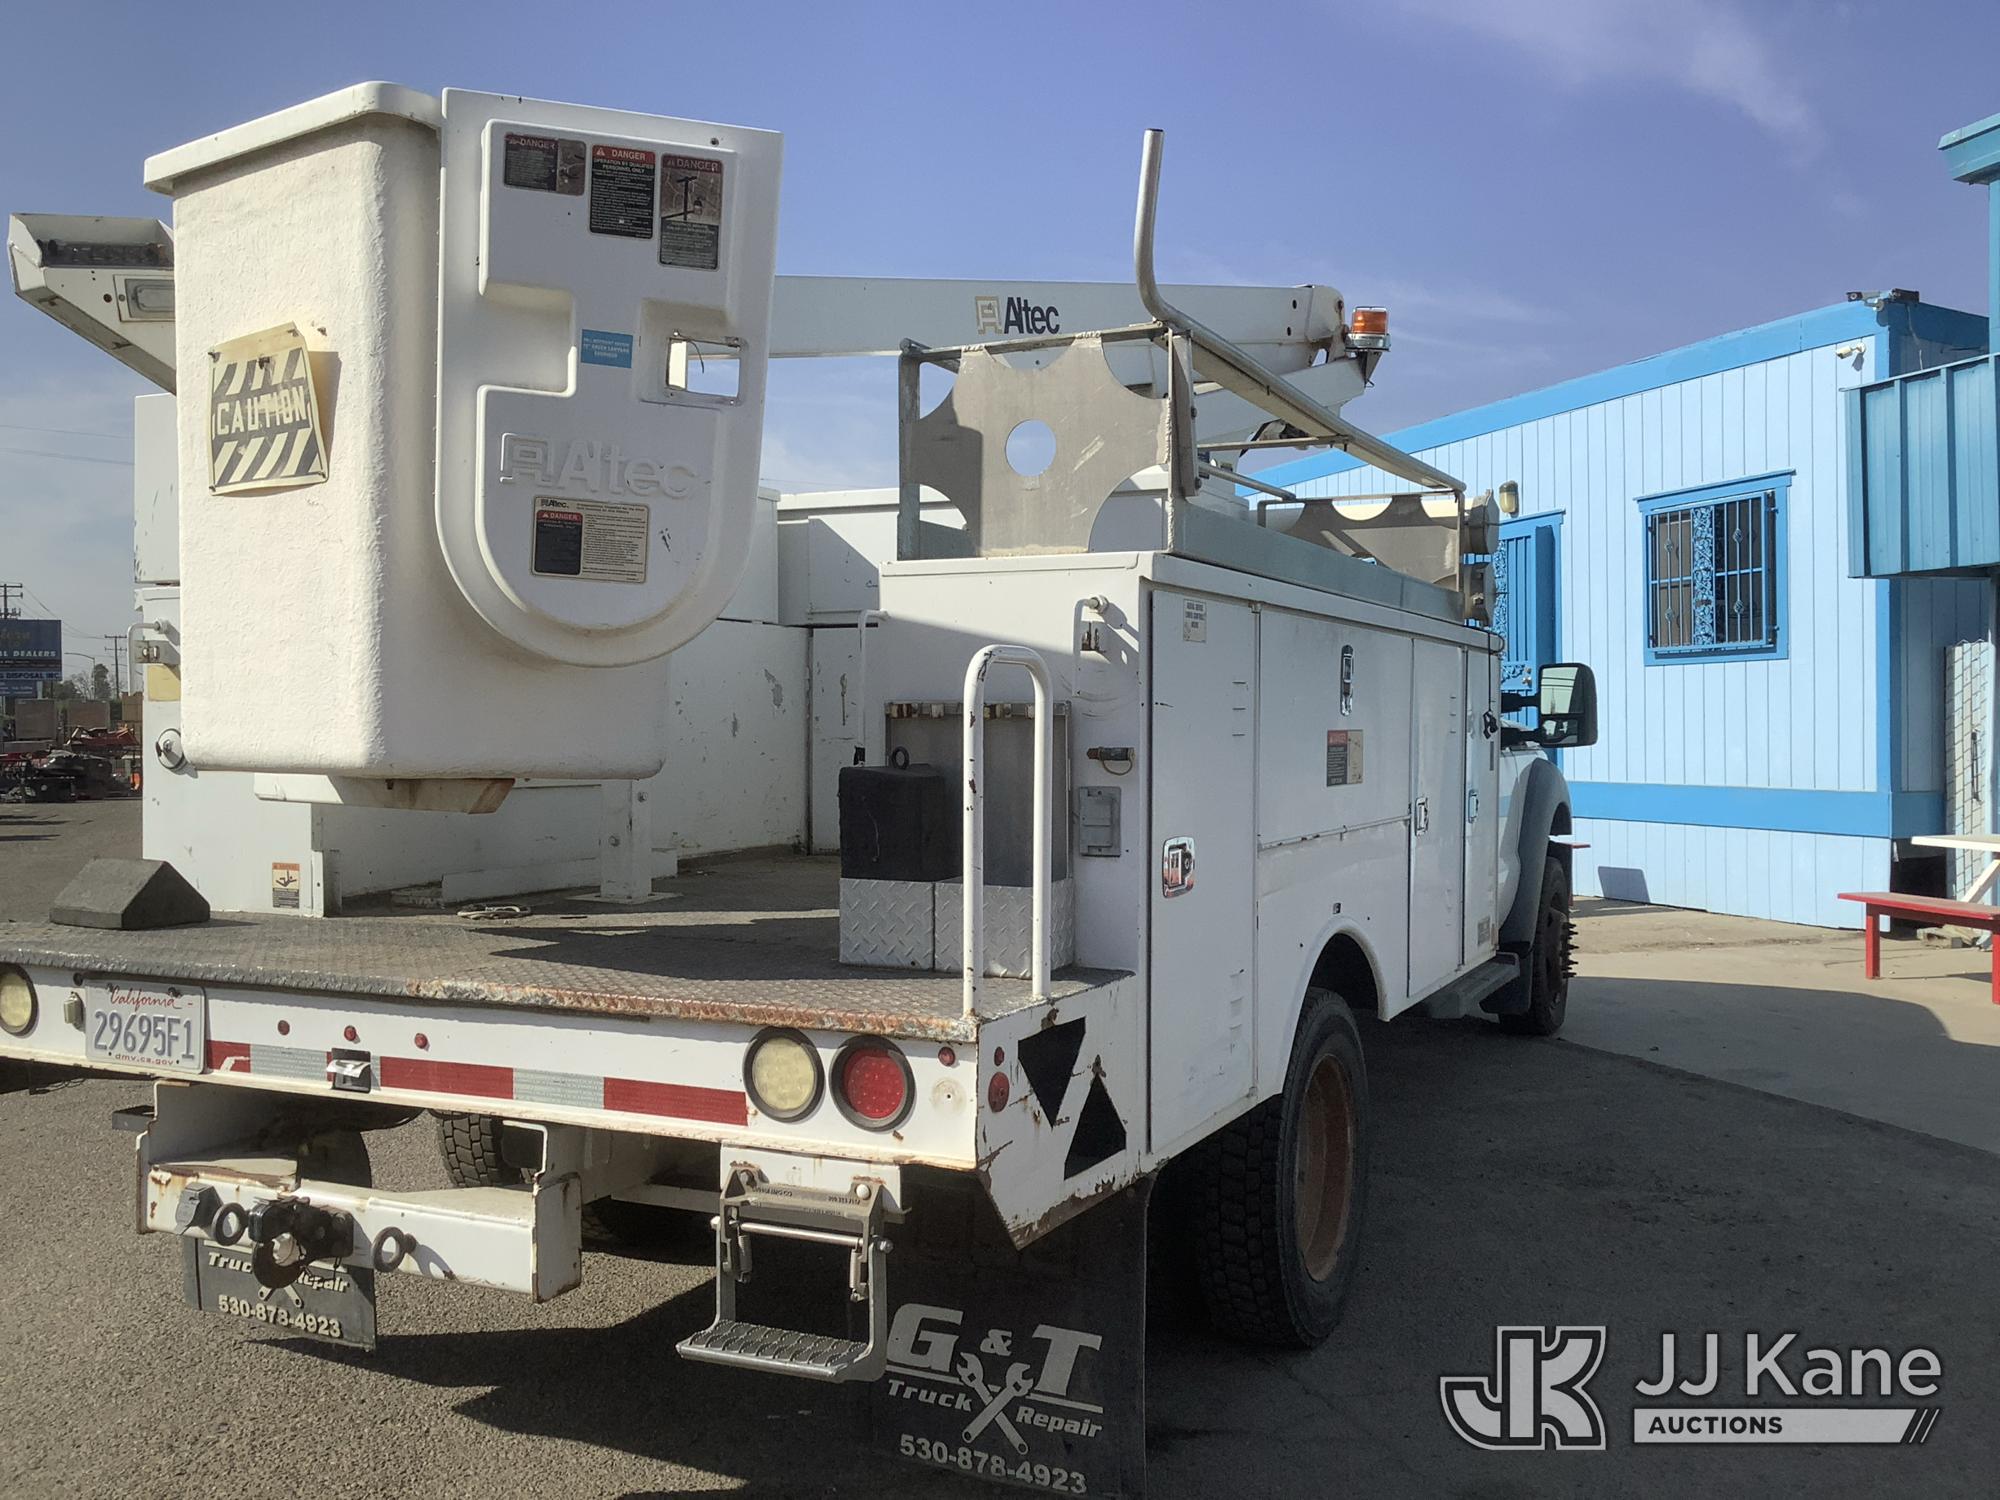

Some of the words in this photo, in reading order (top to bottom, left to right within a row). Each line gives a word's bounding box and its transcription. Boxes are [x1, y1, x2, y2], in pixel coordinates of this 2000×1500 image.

[520, 138, 555, 150] DANGER
[611, 149, 646, 161] DANGER
[676, 158, 719, 171] DANGER
[1004, 296, 1060, 334] Altec
[216, 385, 307, 435] CAUTION
[558, 440, 698, 499] Altec
[550, 513, 578, 521] DANGER
[110, 985, 182, 1012] California
[94, 1010, 195, 1060] 29695F1
[115, 1053, 174, 1065] dmv.ca.gov
[208, 1251, 252, 1273] Truc
[218, 1294, 341, 1338] 530-878-4923
[886, 1303, 964, 1373] G
[980, 1328, 1012, 1356] &
[1032, 1324, 1102, 1396] T
[888, 1379, 973, 1412] Truck
[1015, 1405, 1103, 1438] Repair
[900, 1433, 1088, 1494] 530-878-4923
